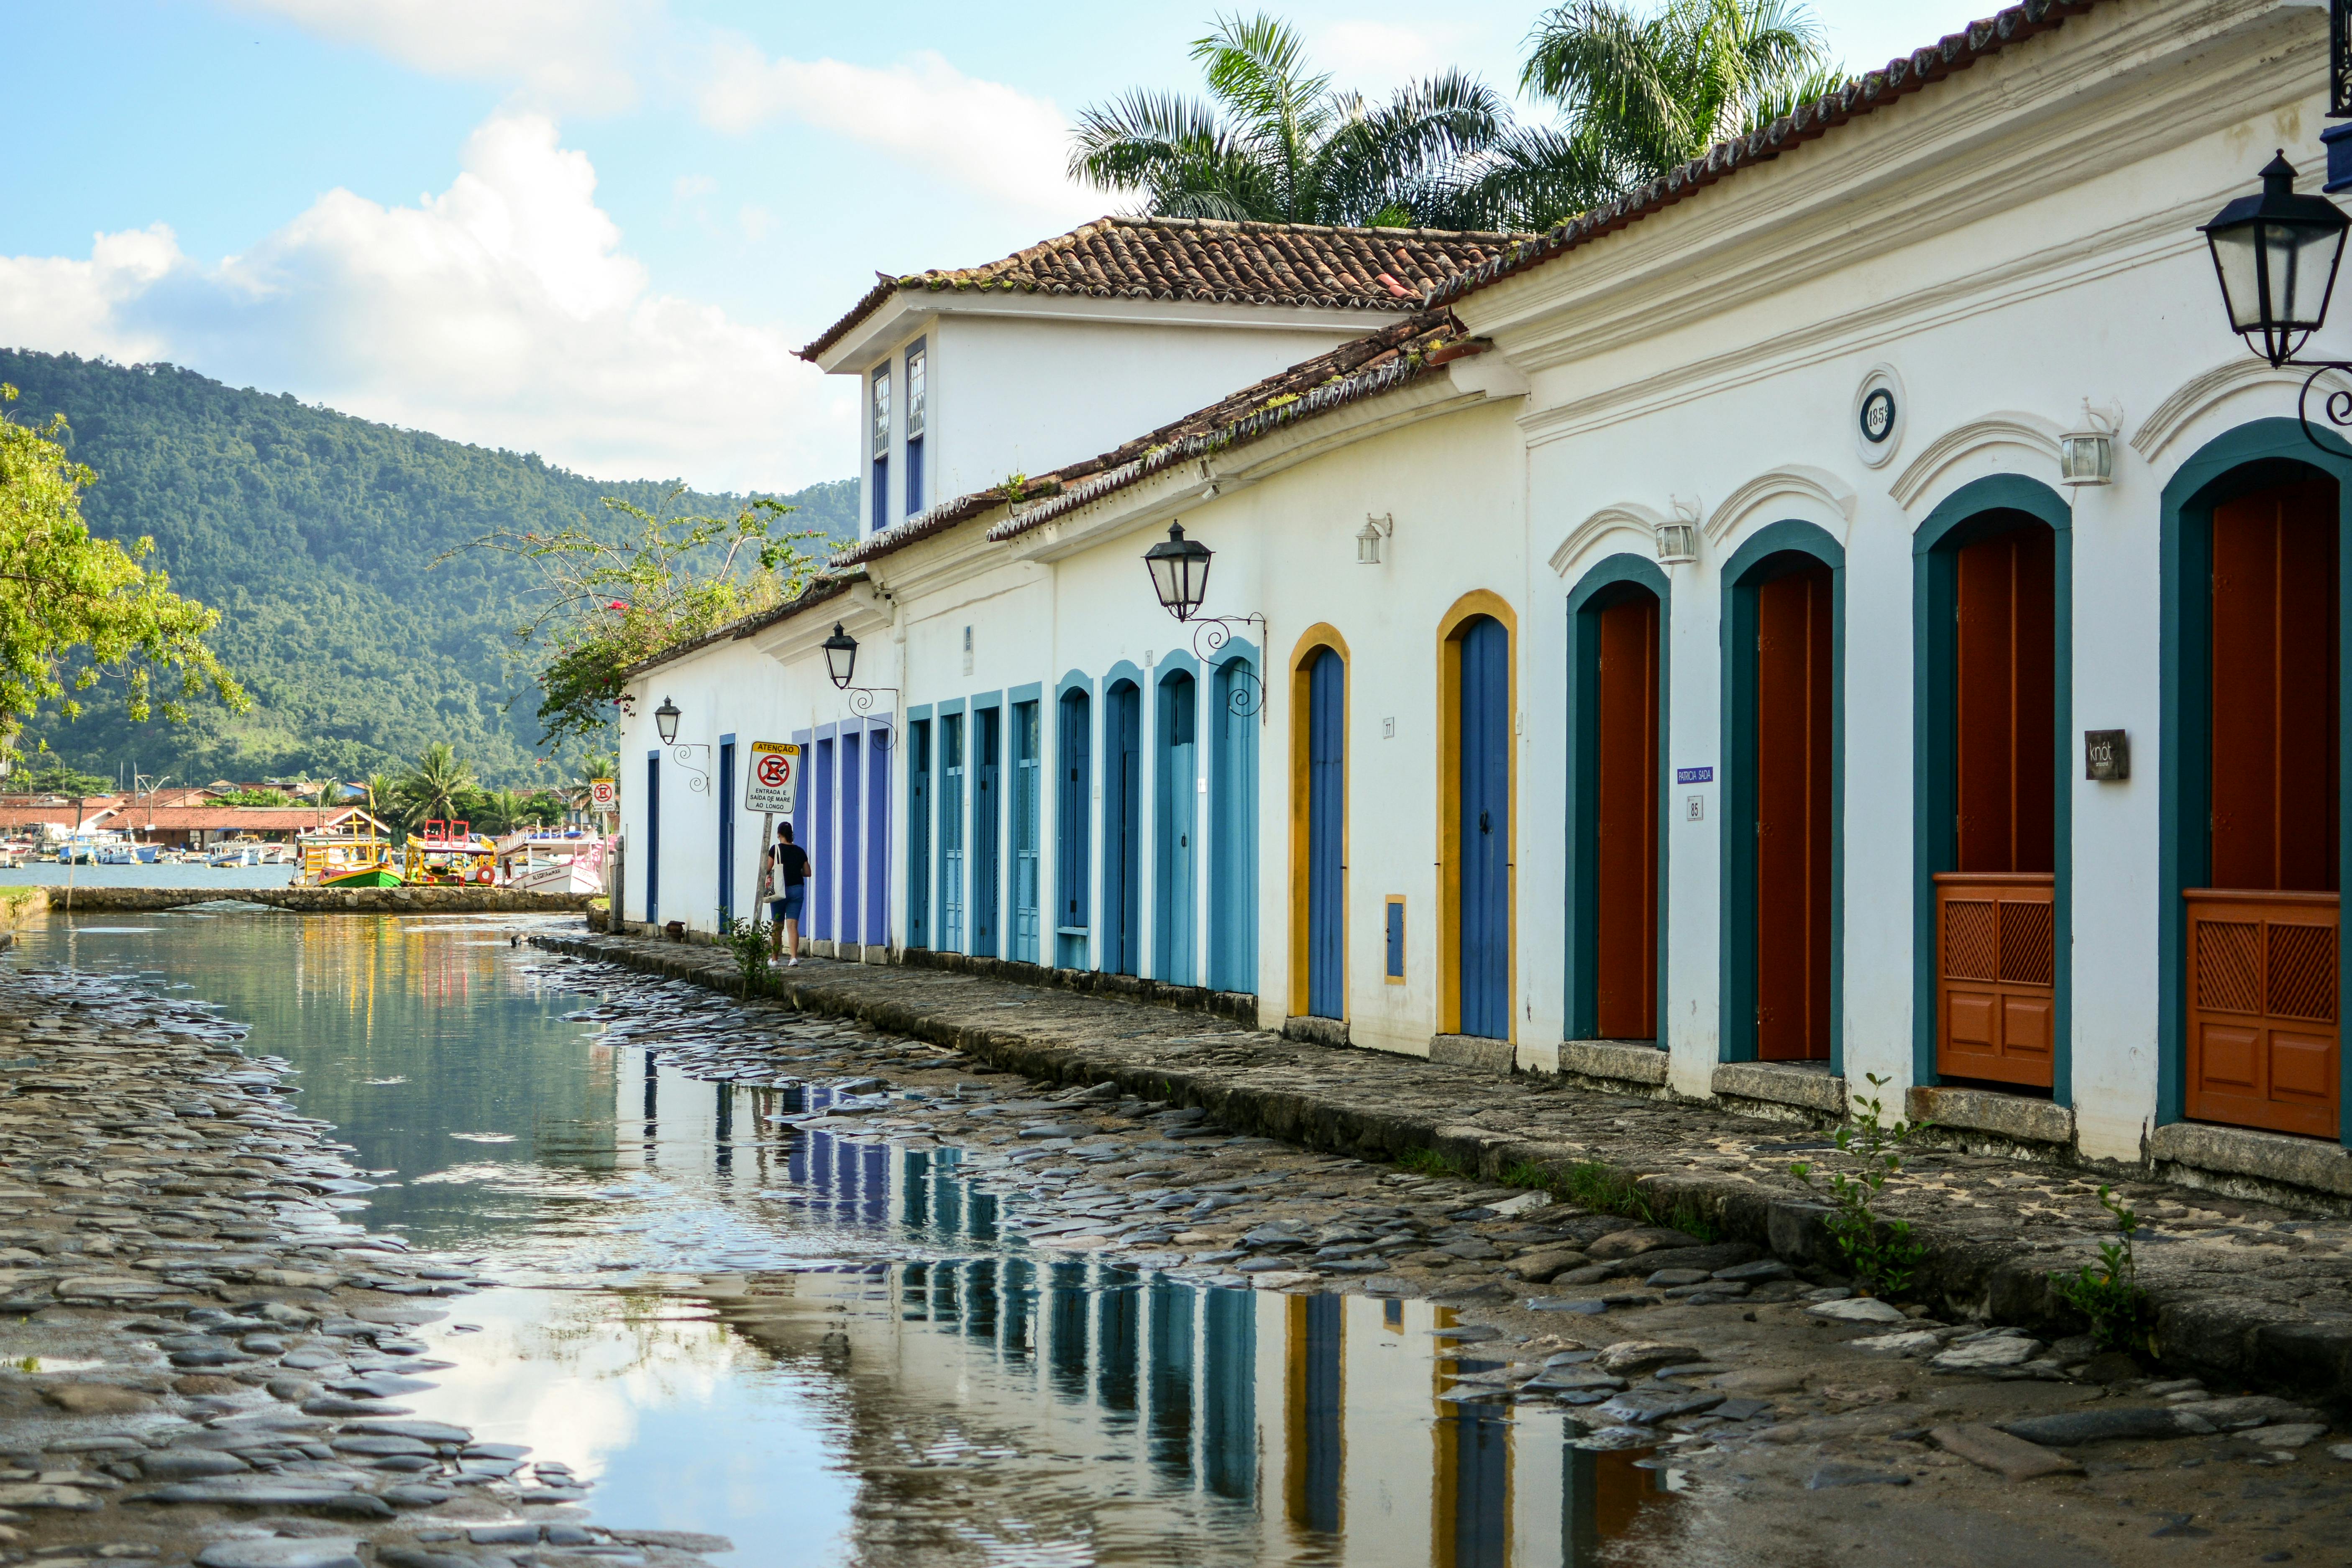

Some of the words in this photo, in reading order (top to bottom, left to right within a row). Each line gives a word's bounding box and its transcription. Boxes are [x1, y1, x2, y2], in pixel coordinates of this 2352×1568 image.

[1386, 724, 1390, 735] 77
[758, 744, 793, 753] ATENÇÃO
[2089, 741, 2111, 761] knót
[1679, 771, 1697, 781] PATRICIA
[1699, 770, 1711, 780] SADA
[1691, 803, 1698, 816] 85
